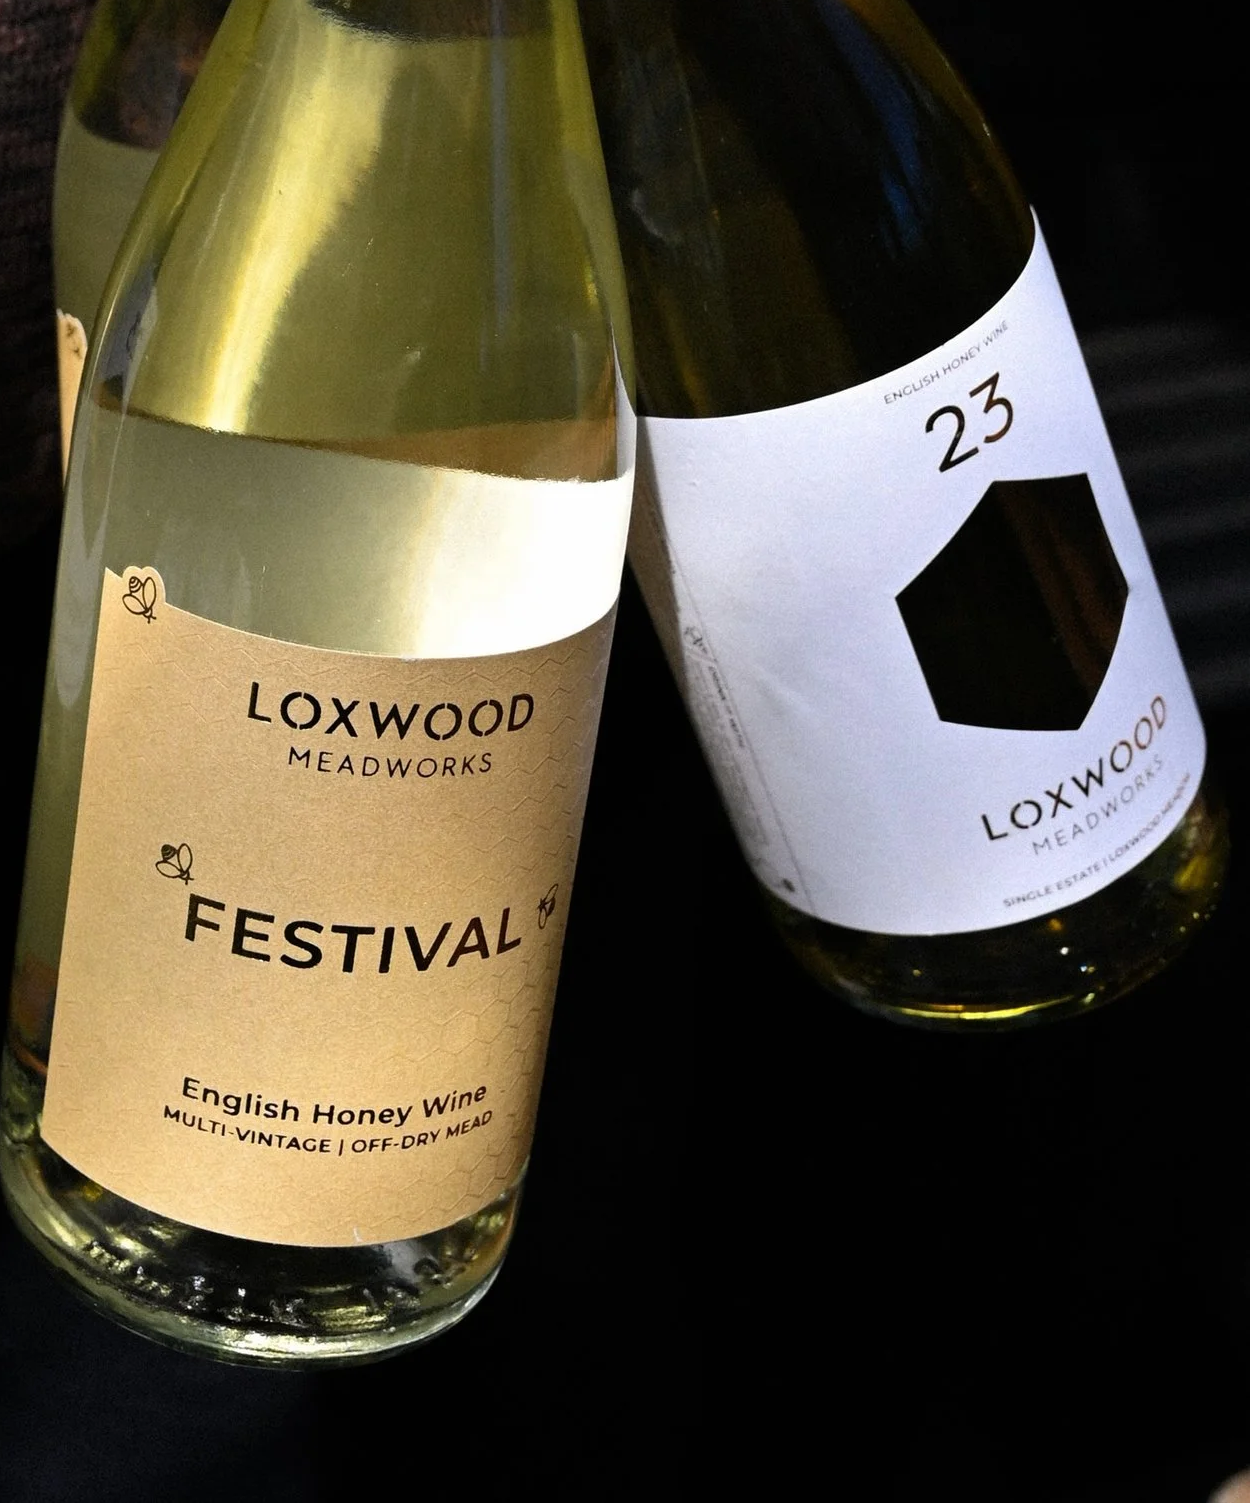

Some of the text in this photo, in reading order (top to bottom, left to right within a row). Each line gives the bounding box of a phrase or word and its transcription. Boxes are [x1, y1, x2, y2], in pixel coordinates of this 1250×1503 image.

[883, 320, 1009, 405] ENGLISH HONEY WINE
[925, 371, 1014, 473] 23
[248, 681, 535, 742] LOXWOOD
[288, 746, 493, 779] MEADWORKS
[981, 695, 1167, 841] LOXWOOD
[1031, 754, 1164, 856] MEADWORKS
[1003, 883, 1052, 908] SINGLE
[1055, 864, 1101, 891] ESTATE
[184, 892, 523, 975] FESTIVAL
[163, 1105, 332, 1154] MULTI-VINTAGE
[351, 1128, 441, 1154] OFF-DRY
[445, 1109, 494, 1140] MEAD
[181, 1076, 488, 1128] English Honey Wine
